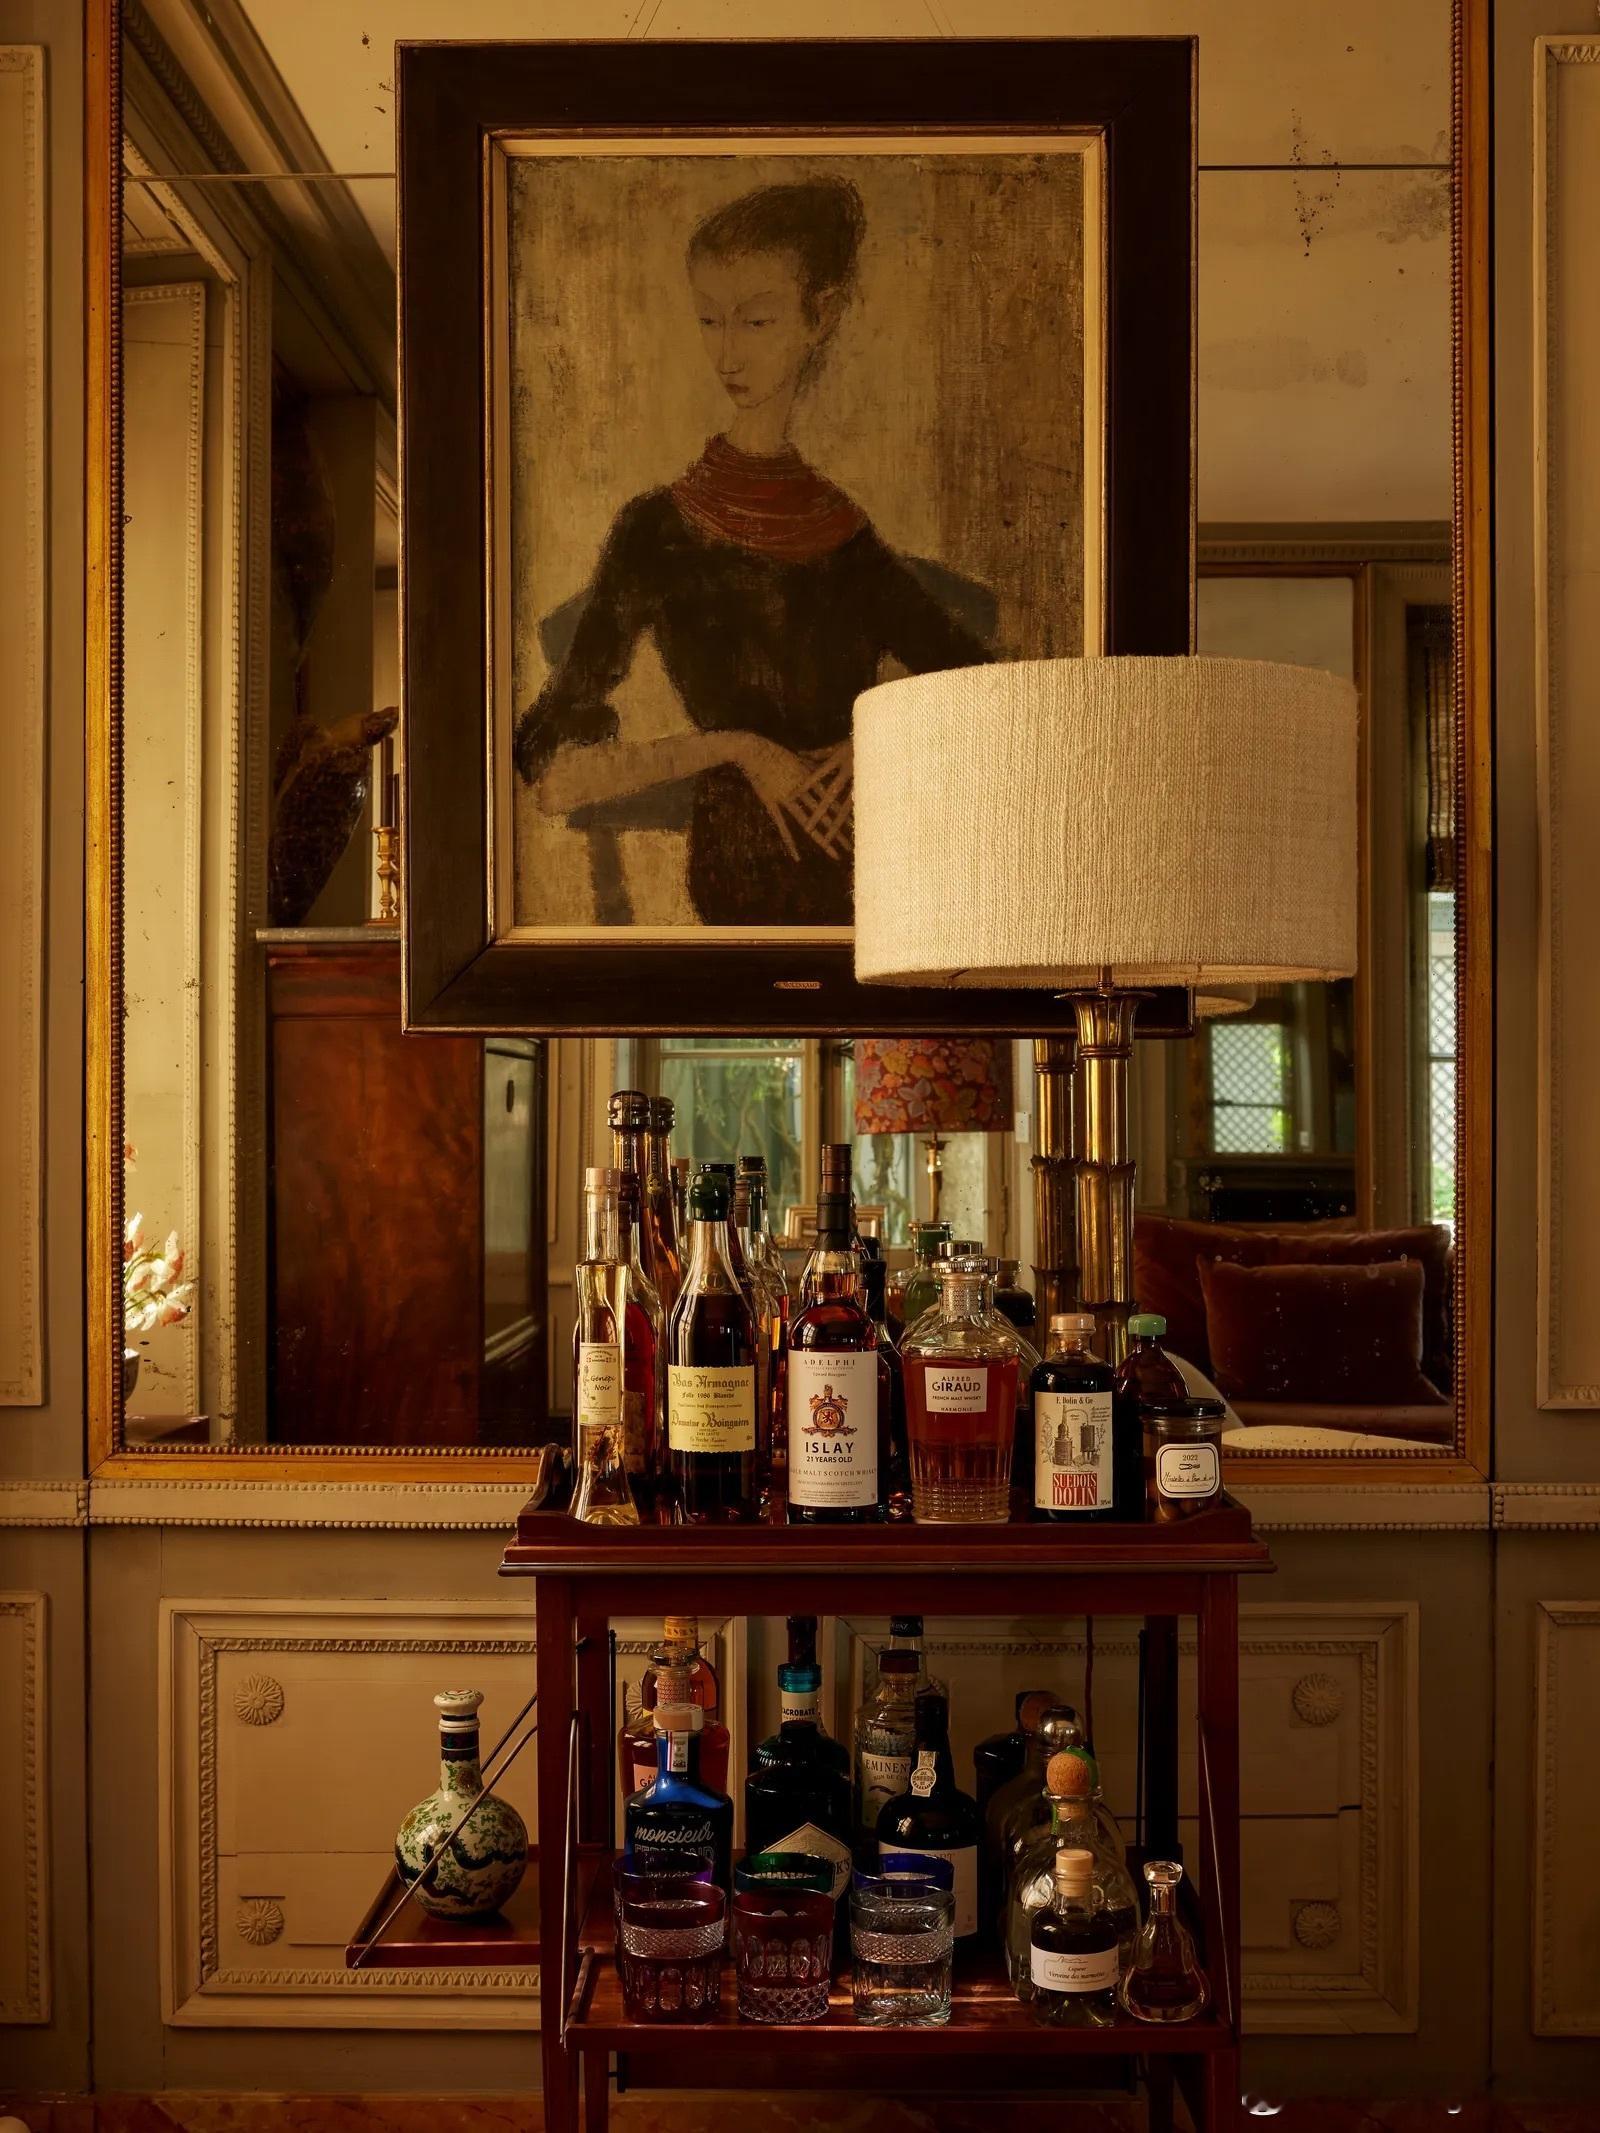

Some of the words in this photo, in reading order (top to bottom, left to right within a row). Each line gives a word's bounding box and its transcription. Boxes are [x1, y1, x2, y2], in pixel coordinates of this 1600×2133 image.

[671, 1373, 693, 1388] Bas
[694, 1375, 750, 1391] Armagnac
[932, 1382, 981, 1392] GIRAUD
[1062, 1396, 1078, 1404] Dolin
[805, 1442, 855, 1454] ISLAY
[1054, 1487, 1097, 1506] DOLIN
[782, 1708, 816, 1716] ACROBATE
[634, 1821, 715, 1844] monsieur
[1048, 1970, 1070, 1979] Verveine
